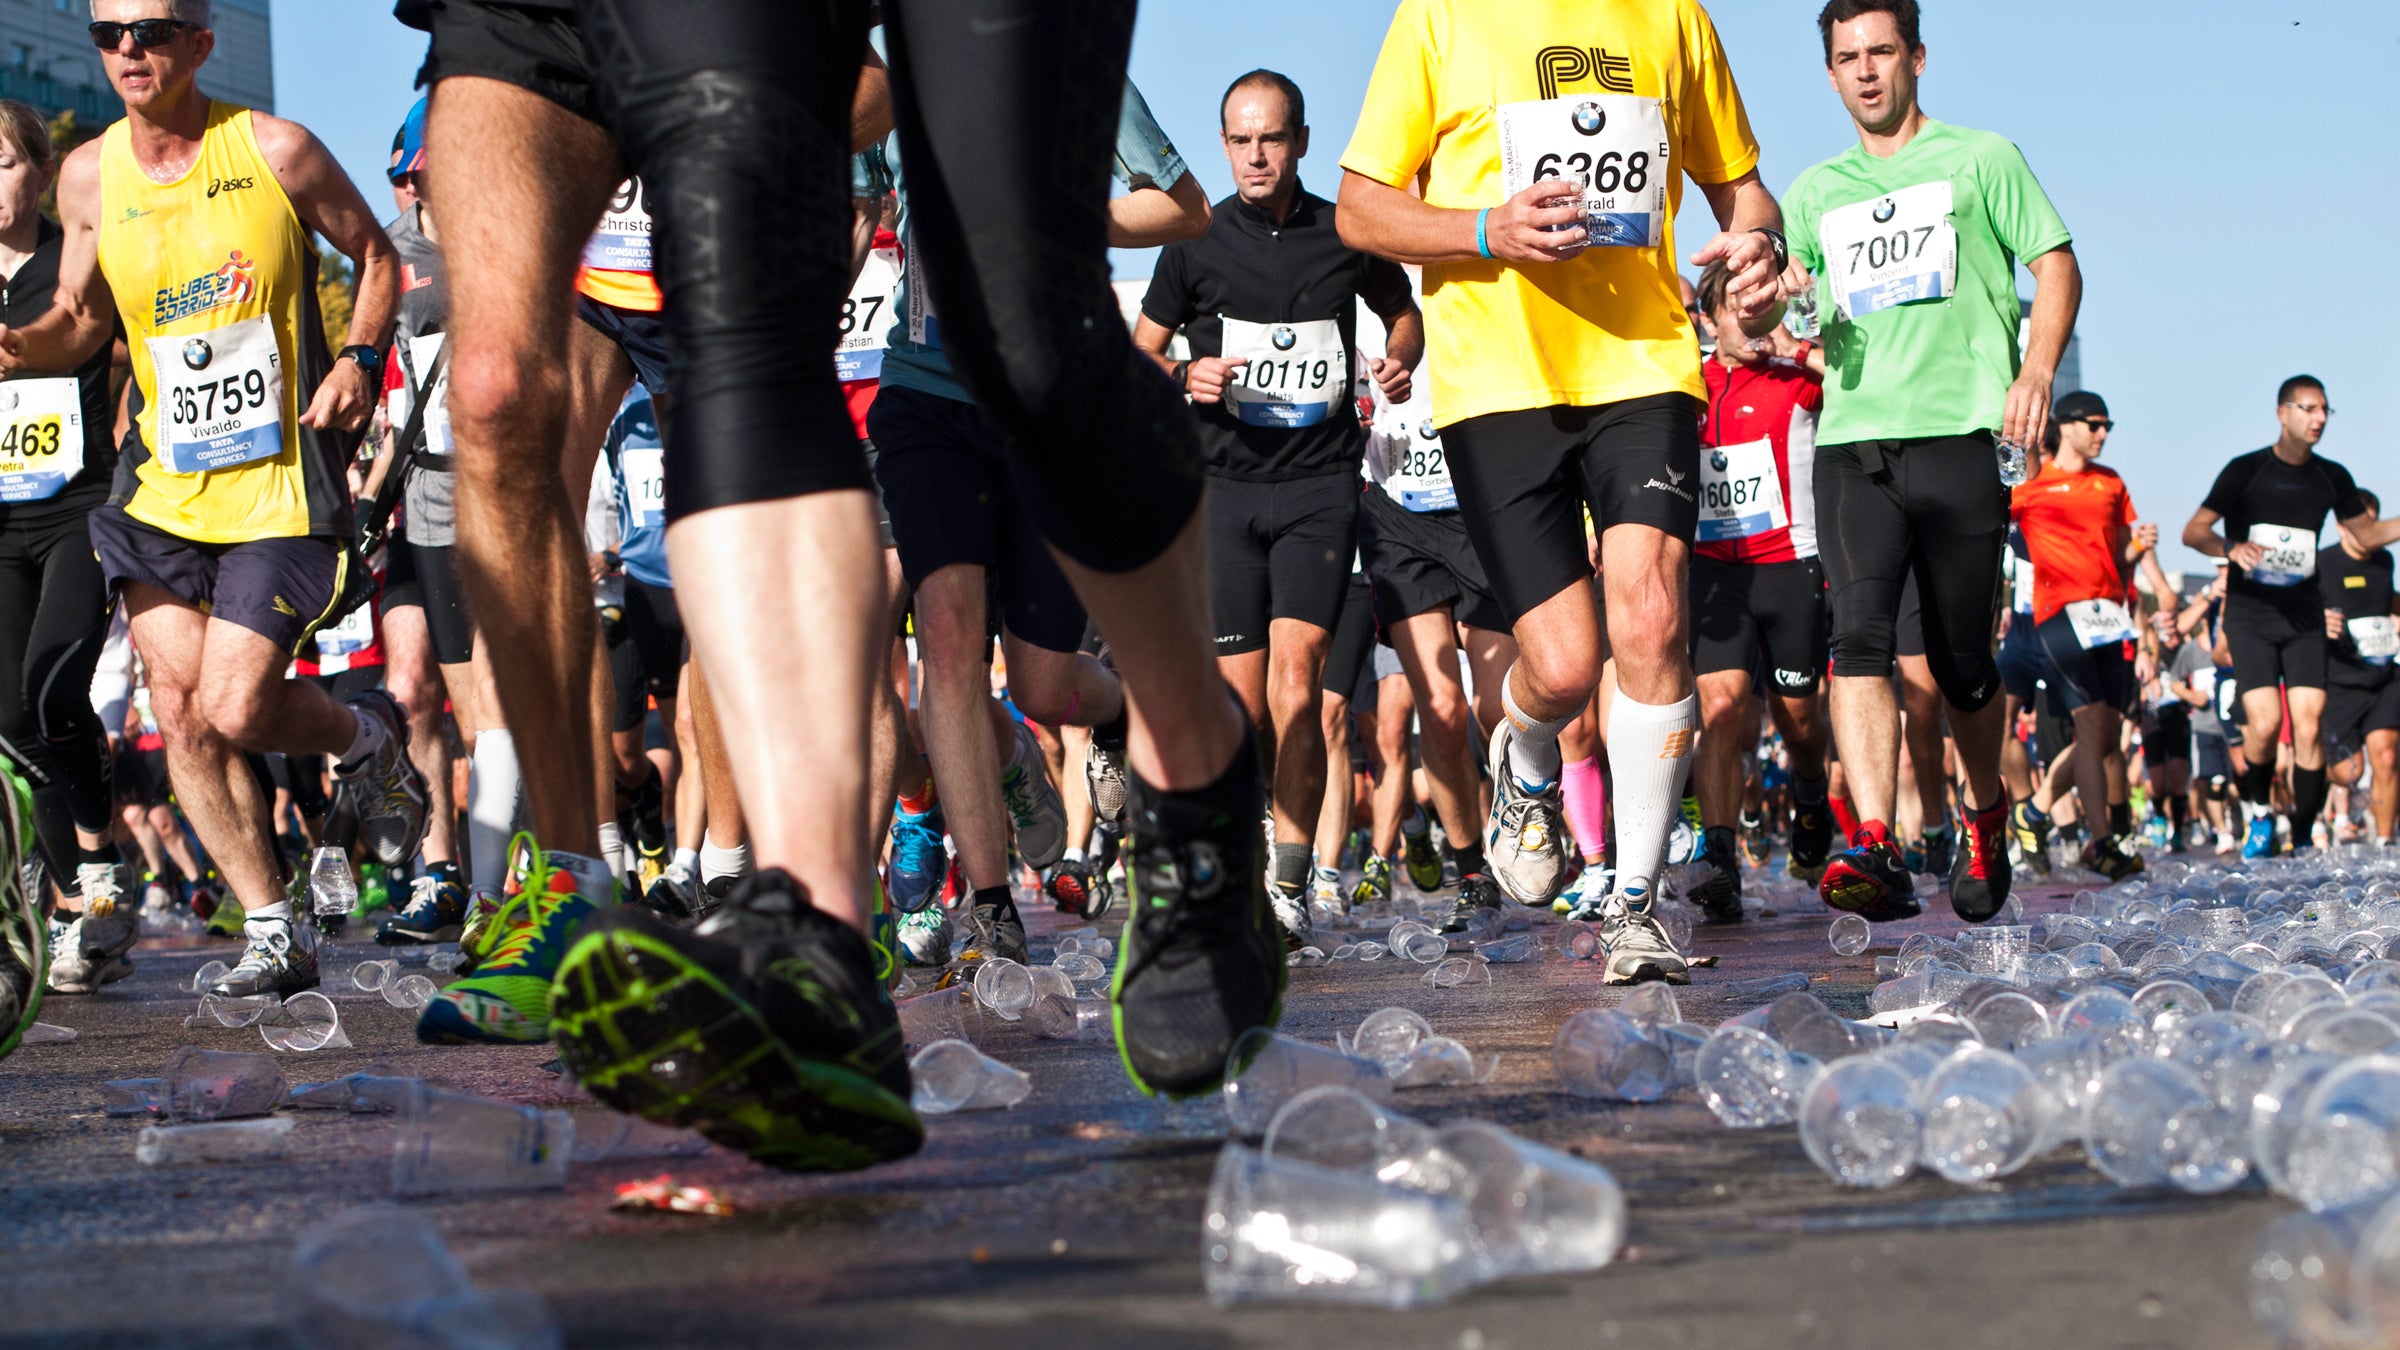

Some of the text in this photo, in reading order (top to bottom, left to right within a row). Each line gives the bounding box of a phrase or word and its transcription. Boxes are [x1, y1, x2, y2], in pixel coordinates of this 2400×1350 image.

[1659, 142, 1668, 157] E
[1846, 225, 1935, 275] 7007
[155, 272, 215, 306] CLUBE
[269, 353, 279, 368] F
[1337, 350, 1344, 361] F
[1242, 359, 1328, 389] 10119
[173, 368, 266, 425] 36759
[71, 414, 80, 425] E
[190, 418, 242, 439] Vivaldo
[197, 441, 253, 461] CONSULTANCY
[208, 437, 234, 449] TATA
[208, 453, 246, 468] SERVICES
